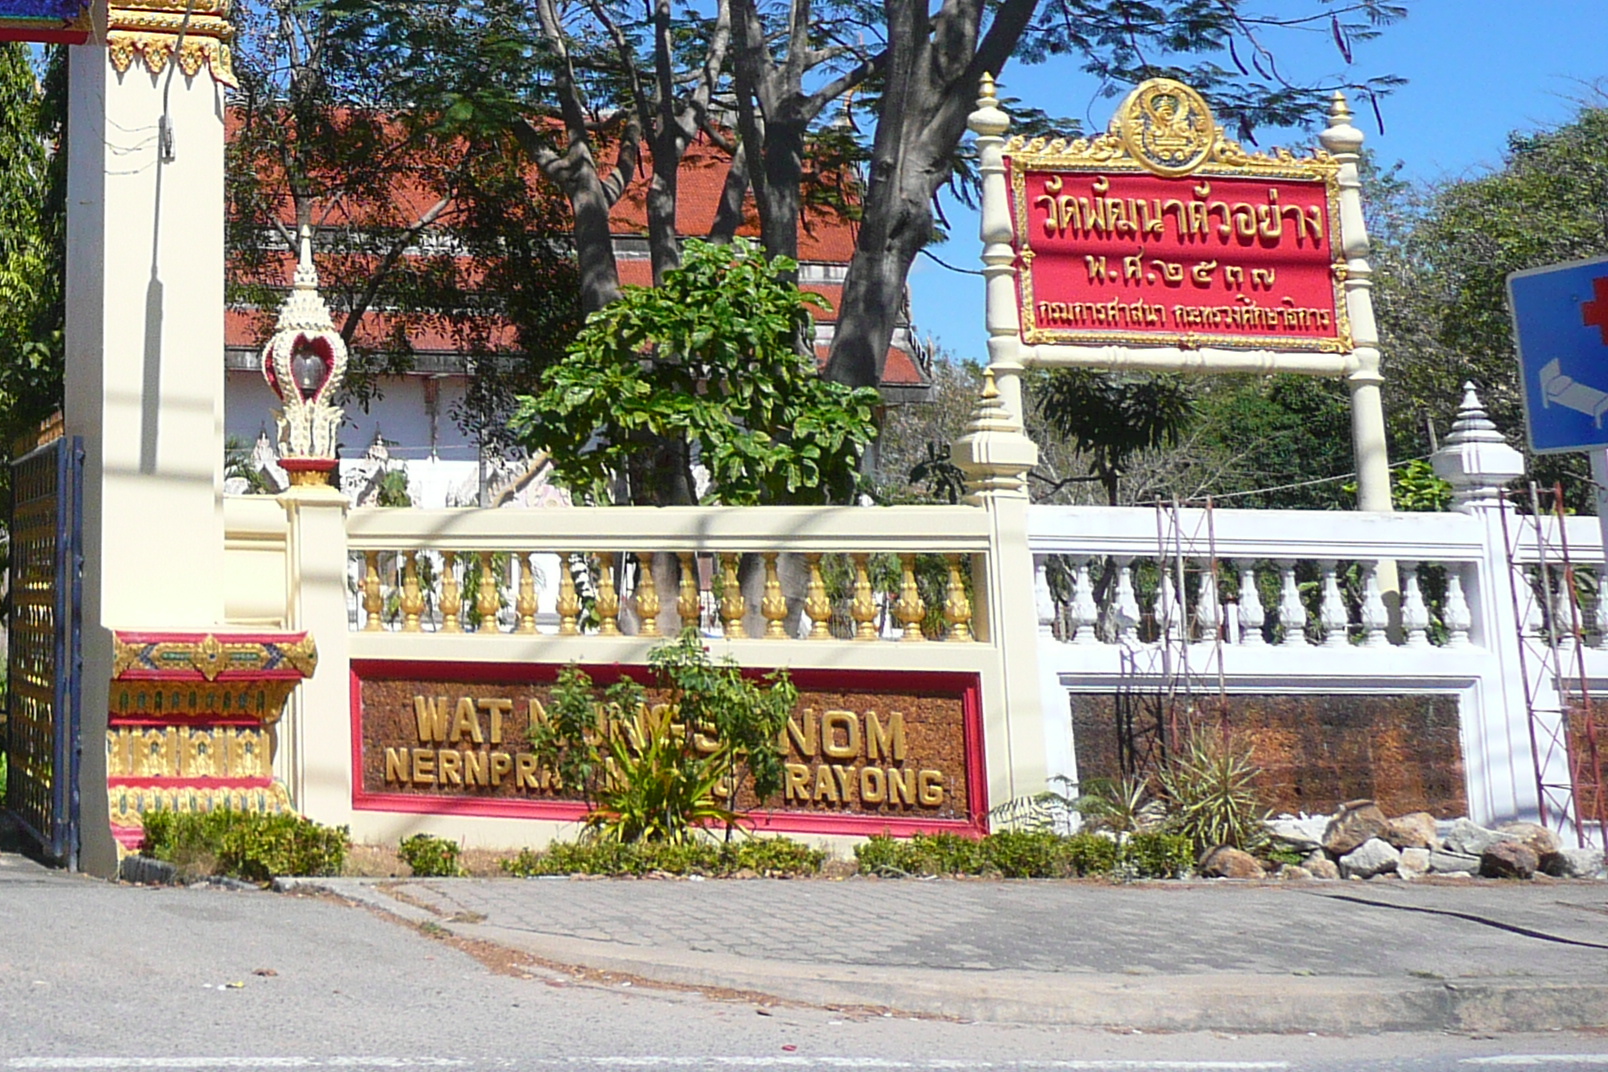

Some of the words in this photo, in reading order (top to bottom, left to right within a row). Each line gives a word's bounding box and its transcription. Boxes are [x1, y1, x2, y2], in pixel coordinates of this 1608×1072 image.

[1036, 176, 1322, 240] วัดพัฒนาตัวอย่าง
[1038, 296, 1165, 324] กรมการศาสนา
[1173, 294, 1330, 327] กระทรวงศึกษาธิการ
[413, 695, 512, 744] WAT
[784, 763, 944, 807] RAYONG
